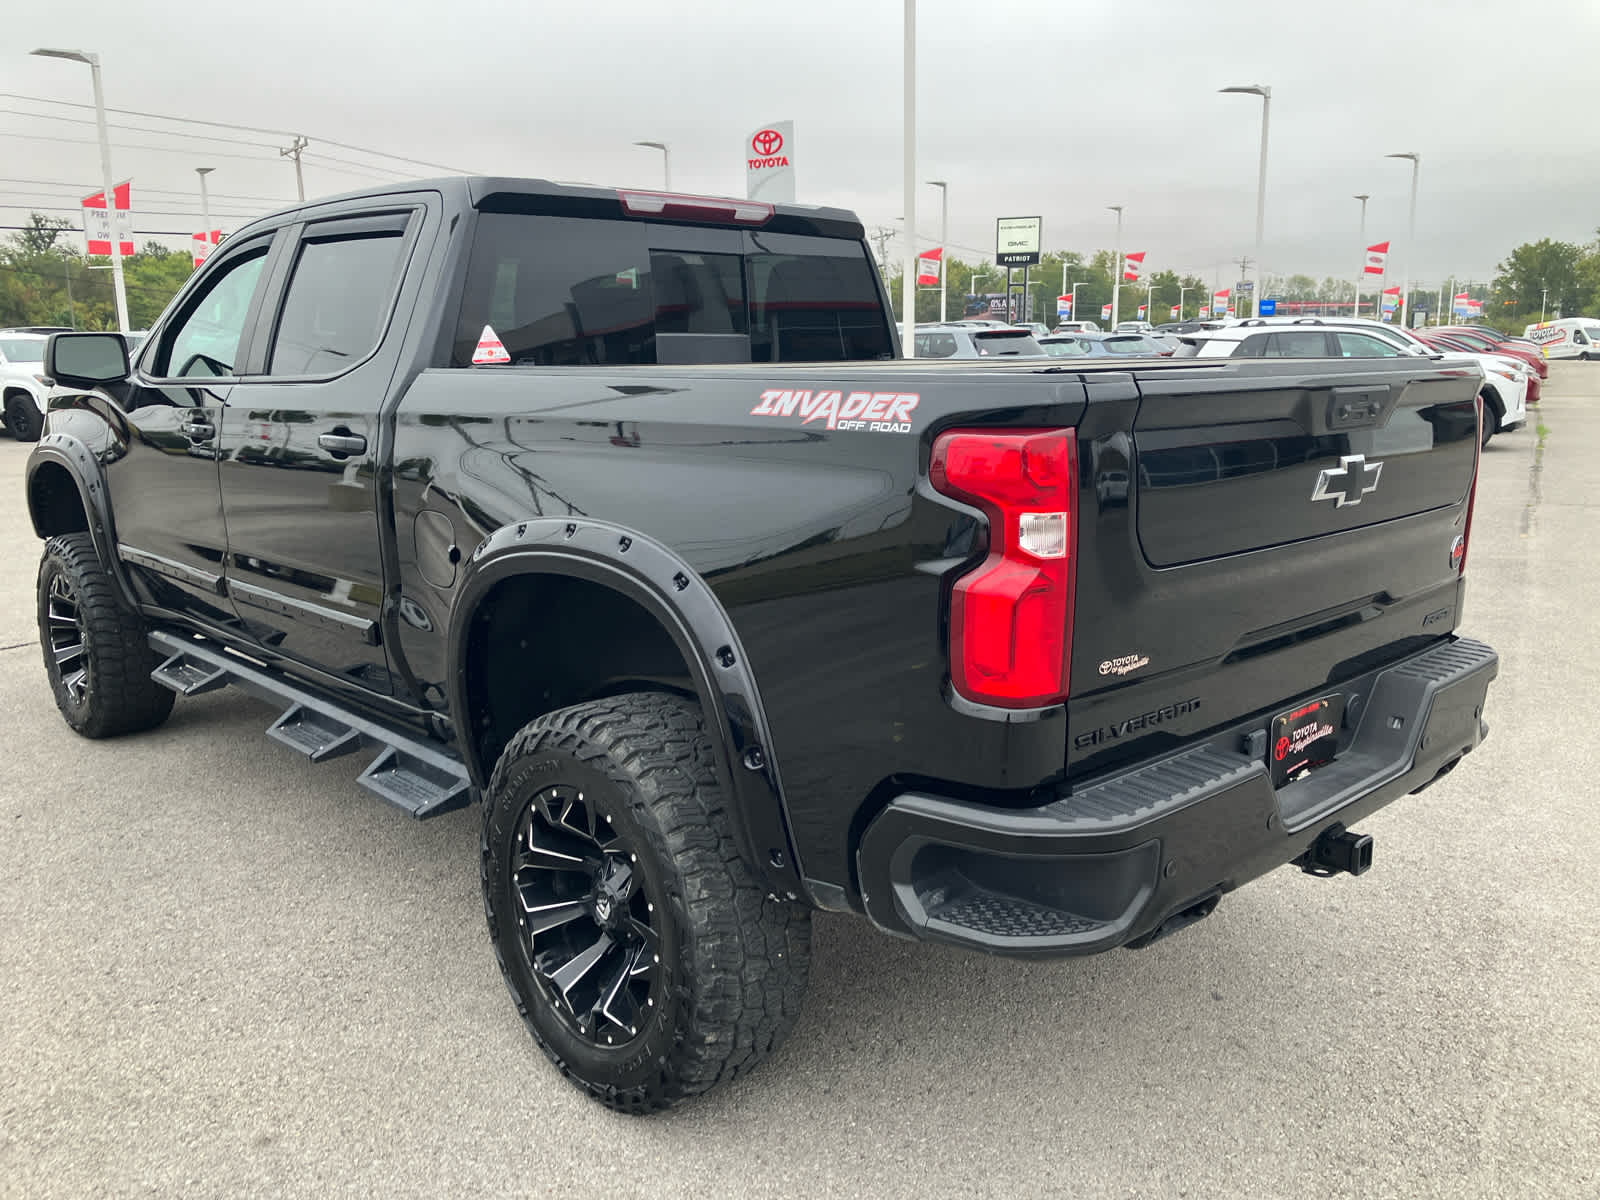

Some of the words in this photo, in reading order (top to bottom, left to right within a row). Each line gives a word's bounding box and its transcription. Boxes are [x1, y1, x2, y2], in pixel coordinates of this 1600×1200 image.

[747, 156, 789, 170] TOYOTA
[97, 232, 125, 240] OWD
[1004, 255, 1031, 263] PATRIOT
[750, 388, 920, 430] INVADER
[836, 420, 867, 431] OFF
[869, 421, 912, 433] ROAD
[1112, 654, 1139, 667] TOYOTA
[1292, 721, 1318, 742] TOYOTA
